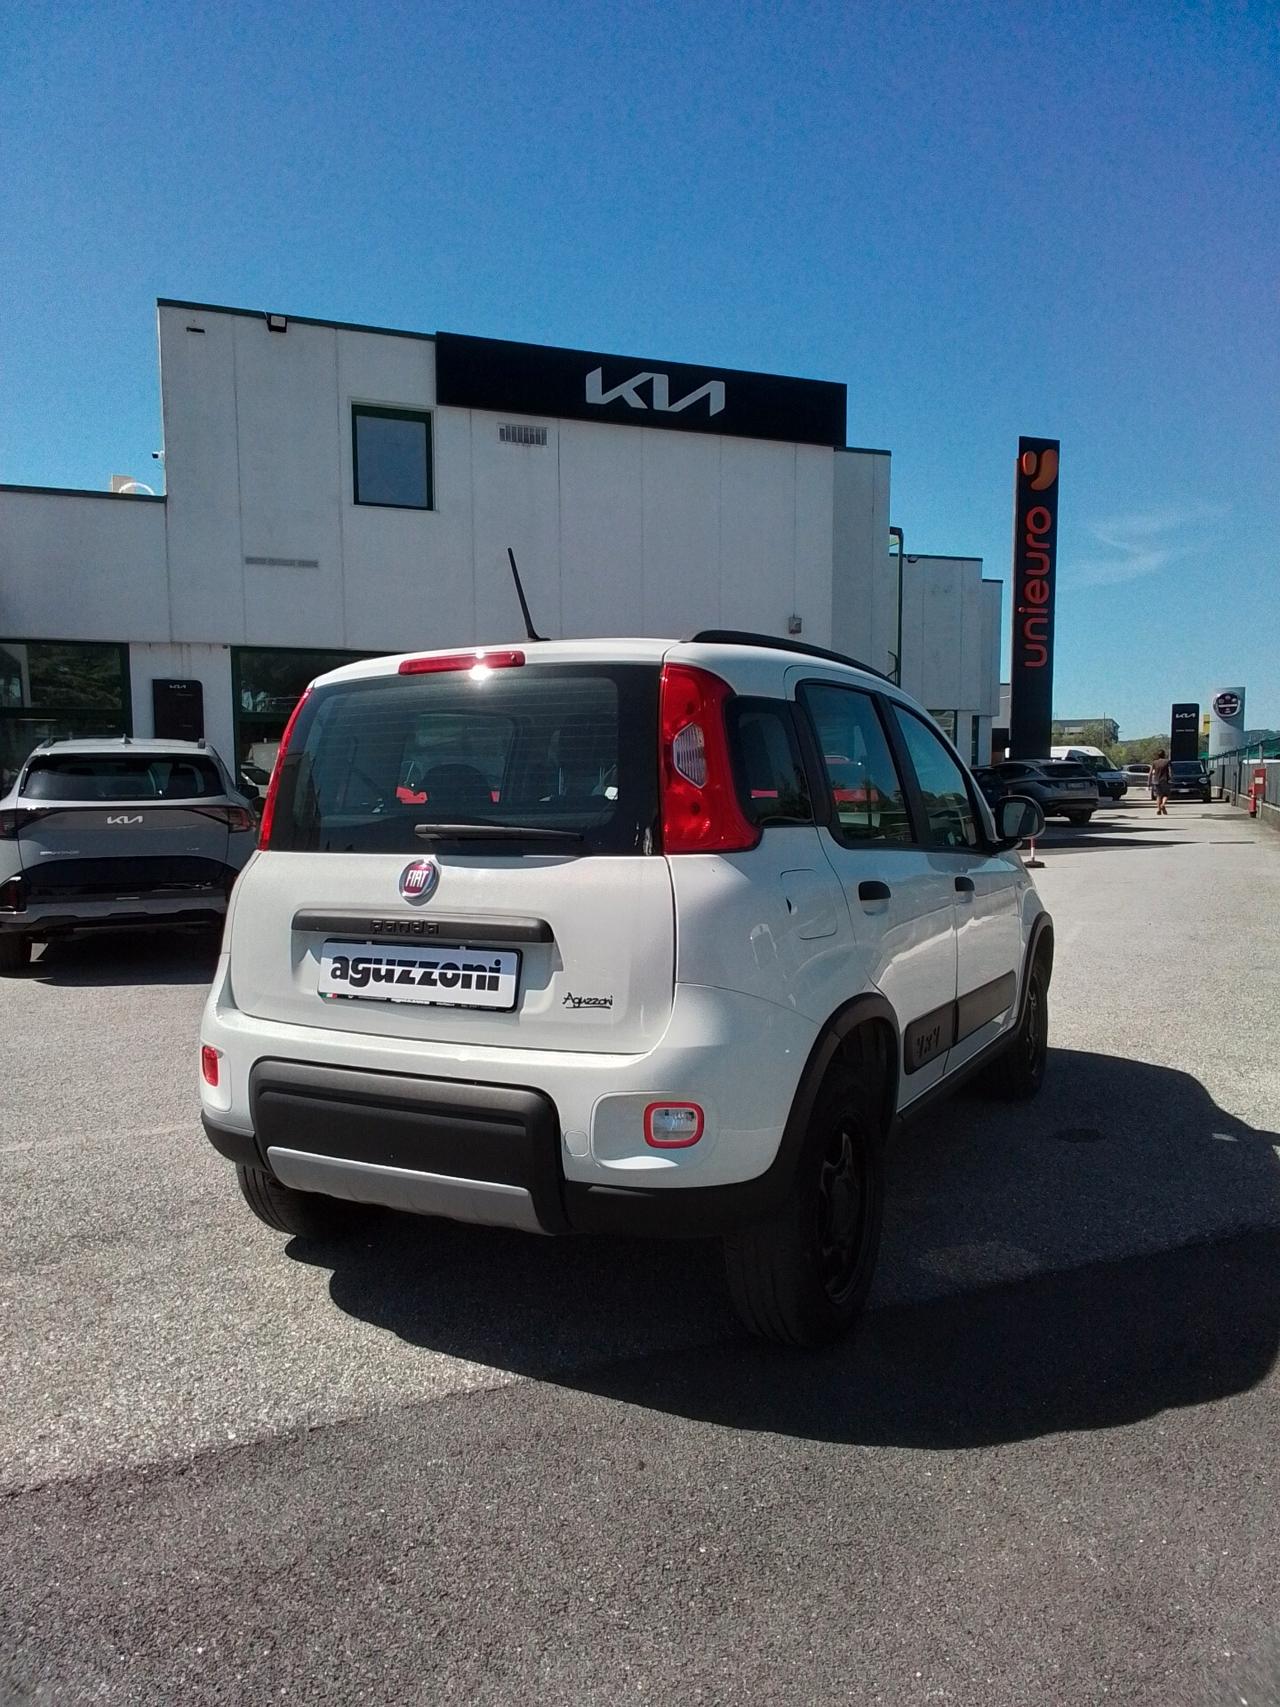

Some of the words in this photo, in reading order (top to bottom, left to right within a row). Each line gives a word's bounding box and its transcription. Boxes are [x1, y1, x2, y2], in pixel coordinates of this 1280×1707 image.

[1018, 505, 1052, 668] unieuro
[405, 869, 429, 888] FIAT
[330, 954, 502, 992] aguzzoni
[562, 992, 613, 1009] Aguzzoni
